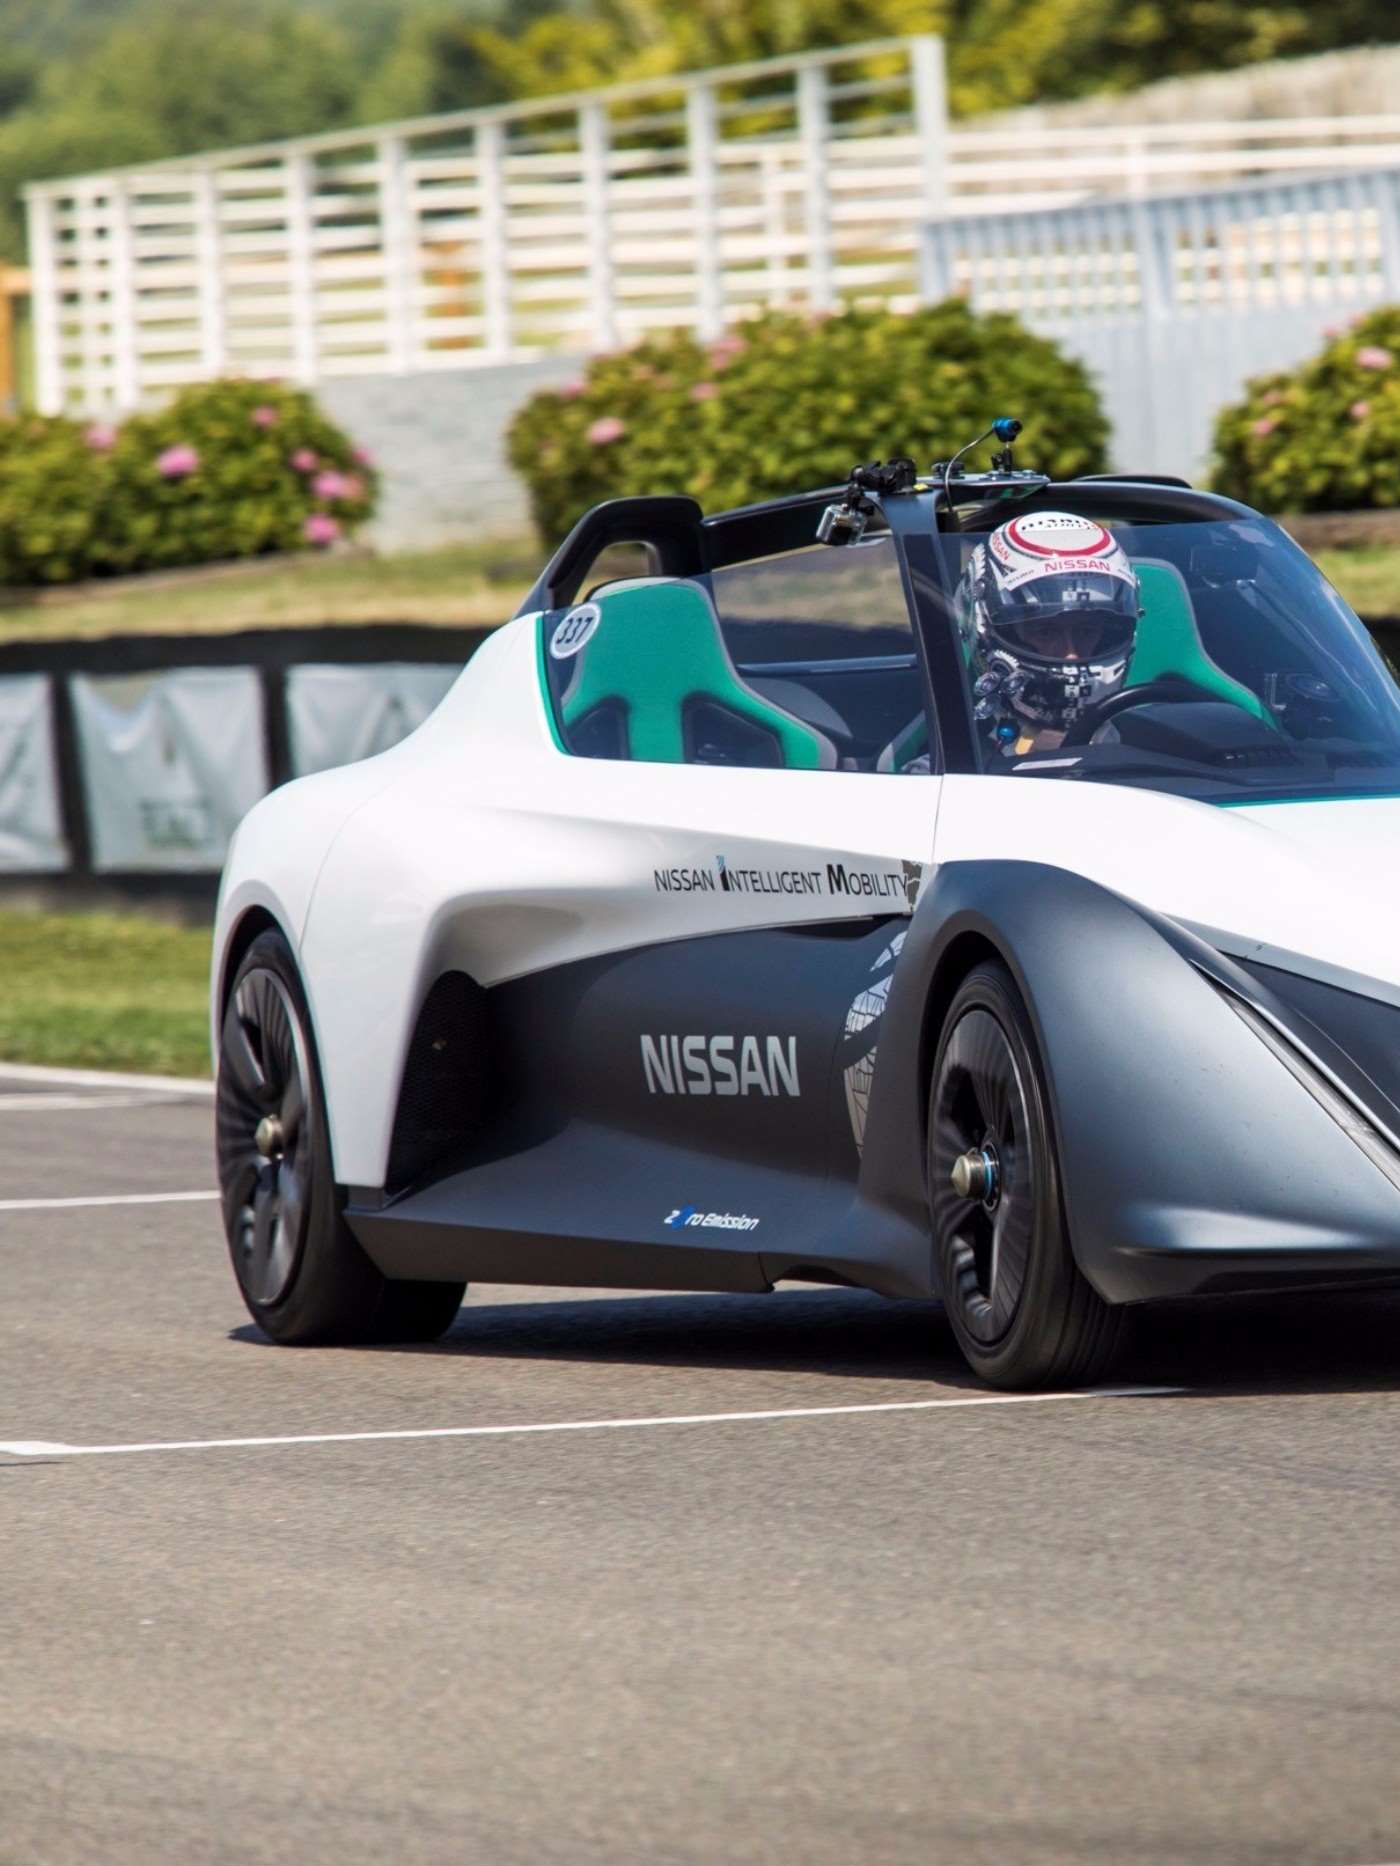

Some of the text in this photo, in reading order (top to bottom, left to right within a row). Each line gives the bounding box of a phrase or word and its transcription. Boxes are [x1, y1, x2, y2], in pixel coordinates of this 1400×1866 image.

[1044, 559, 1111, 573] NISSAN
[555, 616, 594, 644] 337
[654, 869, 716, 892] NISSAN
[826, 863, 908, 896] MOBILITY
[640, 1034, 801, 1096] NISSAN
[701, 1211, 761, 1231] Emission
